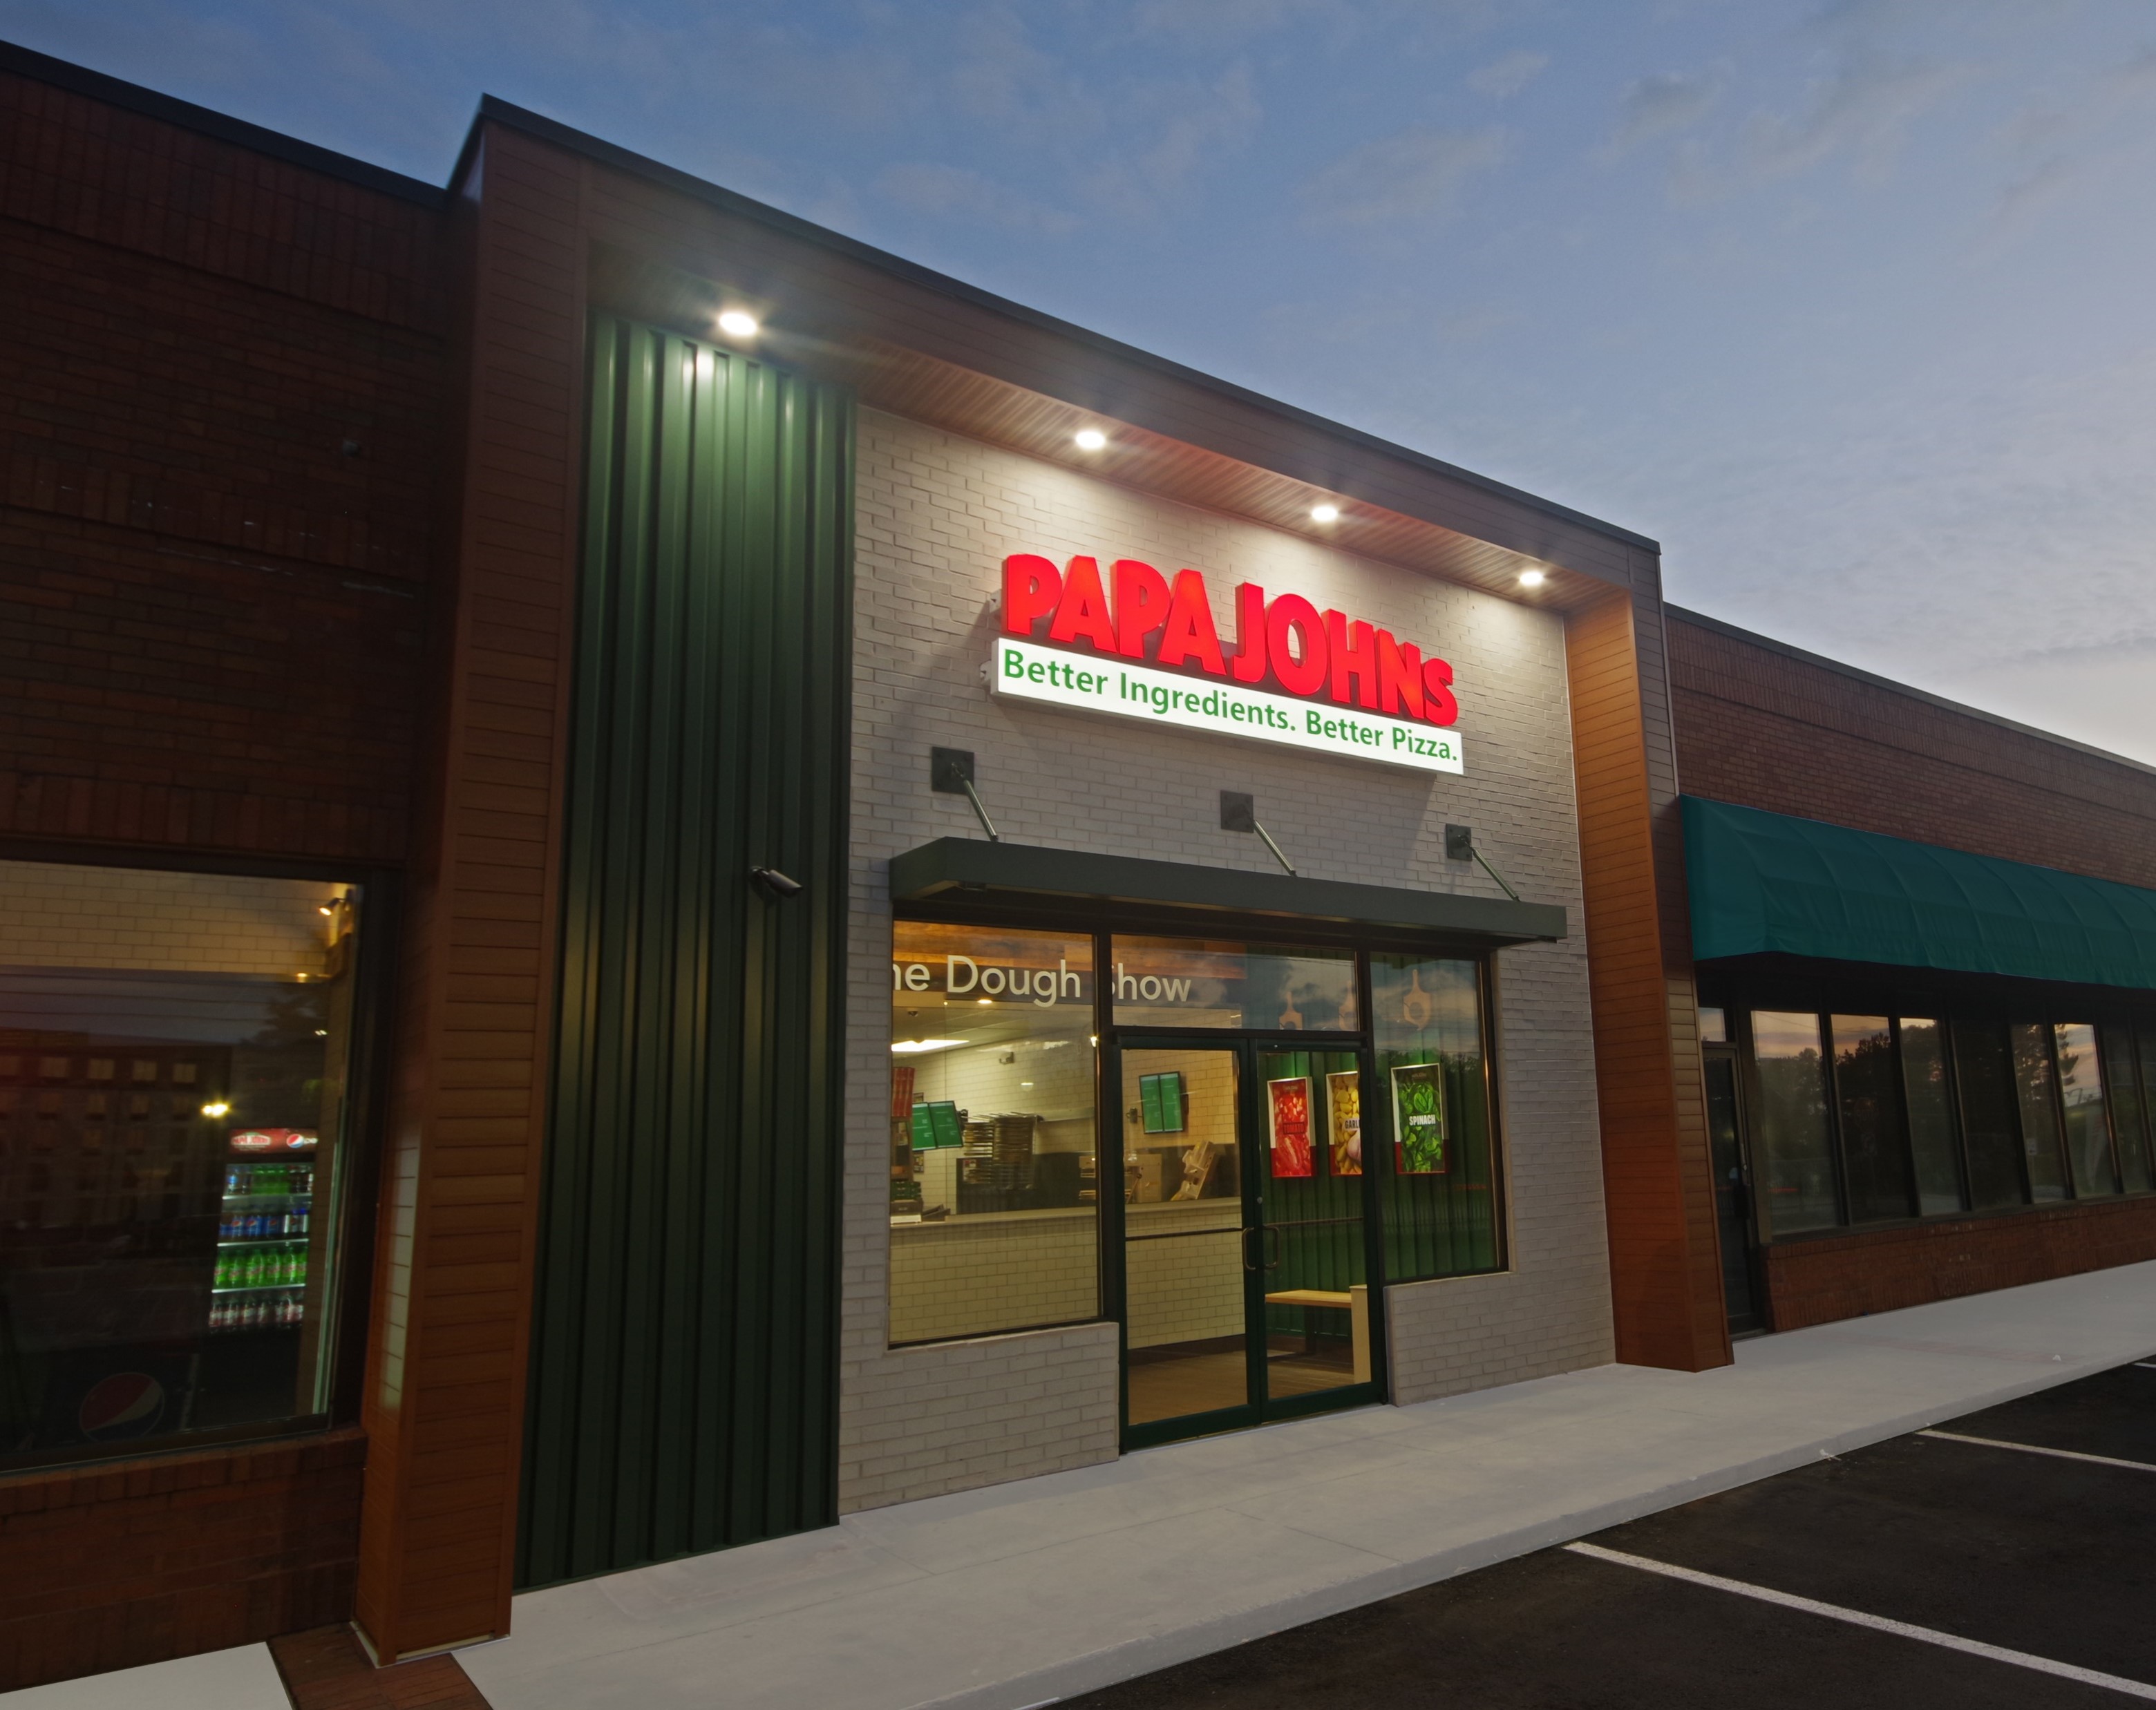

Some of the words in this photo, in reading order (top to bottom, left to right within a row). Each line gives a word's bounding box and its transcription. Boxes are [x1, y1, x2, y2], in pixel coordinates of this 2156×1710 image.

[1001, 553, 1227, 676] PAPA
[1233, 582, 1458, 726] JOHNS
[1003, 649, 1108, 695] Better
[1119, 673, 1296, 732] Ingredients.
[1306, 710, 1383, 748] Better
[1392, 726, 1458, 761] Pizza.
[947, 954, 1081, 1007] Dough
[1112, 962, 1191, 1002] how
[1409, 1114, 1436, 1126] SPINACH
